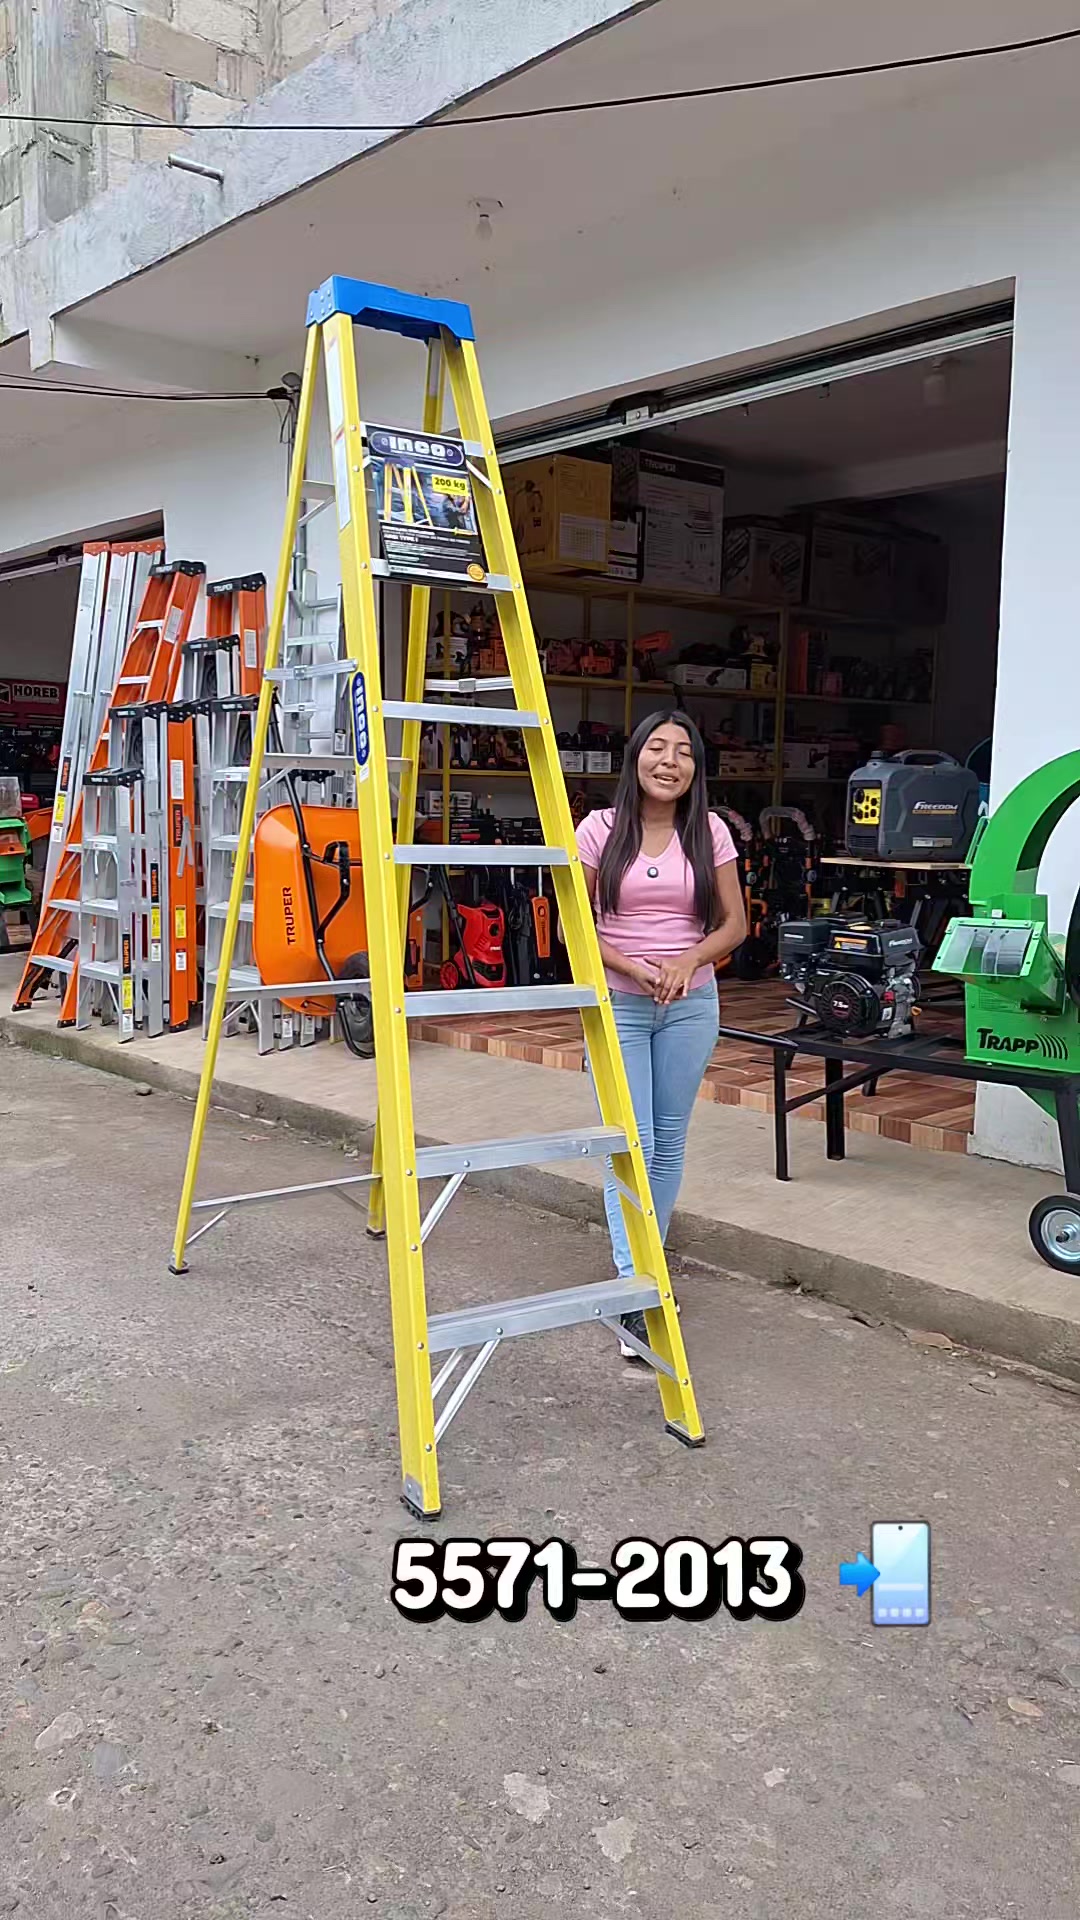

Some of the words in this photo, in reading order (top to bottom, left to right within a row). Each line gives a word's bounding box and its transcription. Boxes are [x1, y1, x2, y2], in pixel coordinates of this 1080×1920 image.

[434, 477, 451, 487] 200
[454, 480, 466, 491] kg
[13, 685, 59, 698] HOREB
[282, 887, 297, 946] TRUPER
[976, 1027, 1040, 1054] TRAPP
